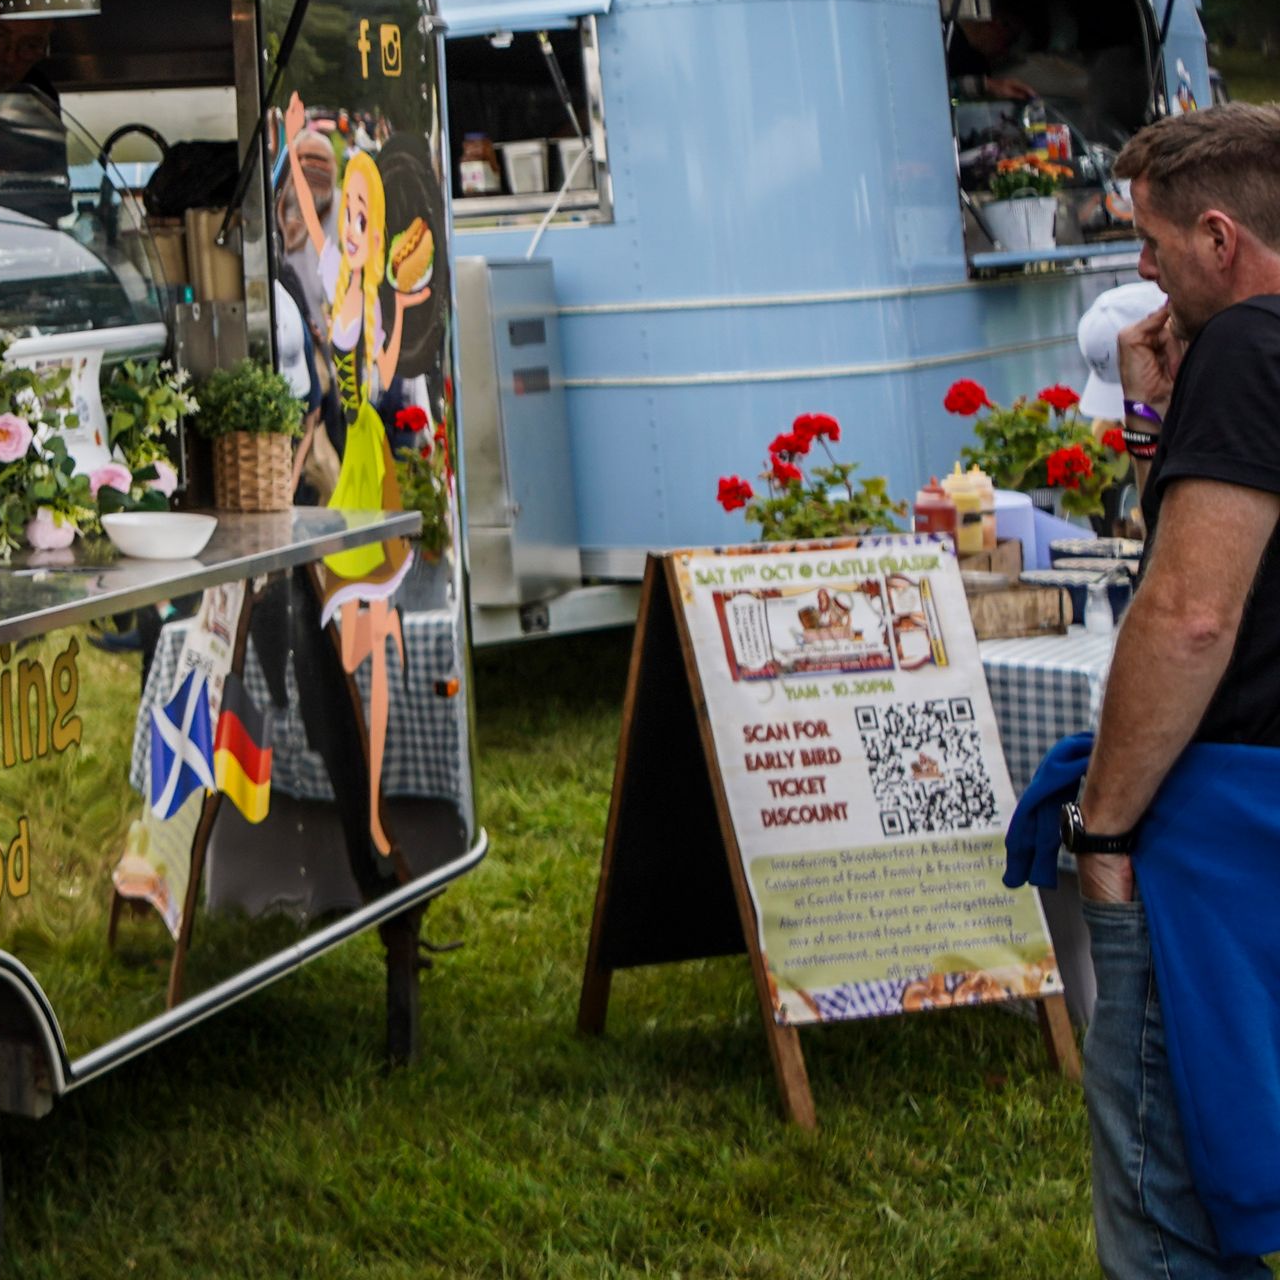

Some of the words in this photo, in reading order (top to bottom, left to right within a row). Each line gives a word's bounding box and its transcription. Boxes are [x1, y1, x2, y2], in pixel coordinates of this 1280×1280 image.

[817, 558, 875, 577] CASTLE
[742, 722, 790, 743] SCAN
[793, 719, 831, 739] FOR
[744, 749, 795, 772] EARLY
[800, 746, 842, 767] BIRD
[768, 775, 826, 798] TICKET
[760, 801, 848, 829] DISCOUNT
